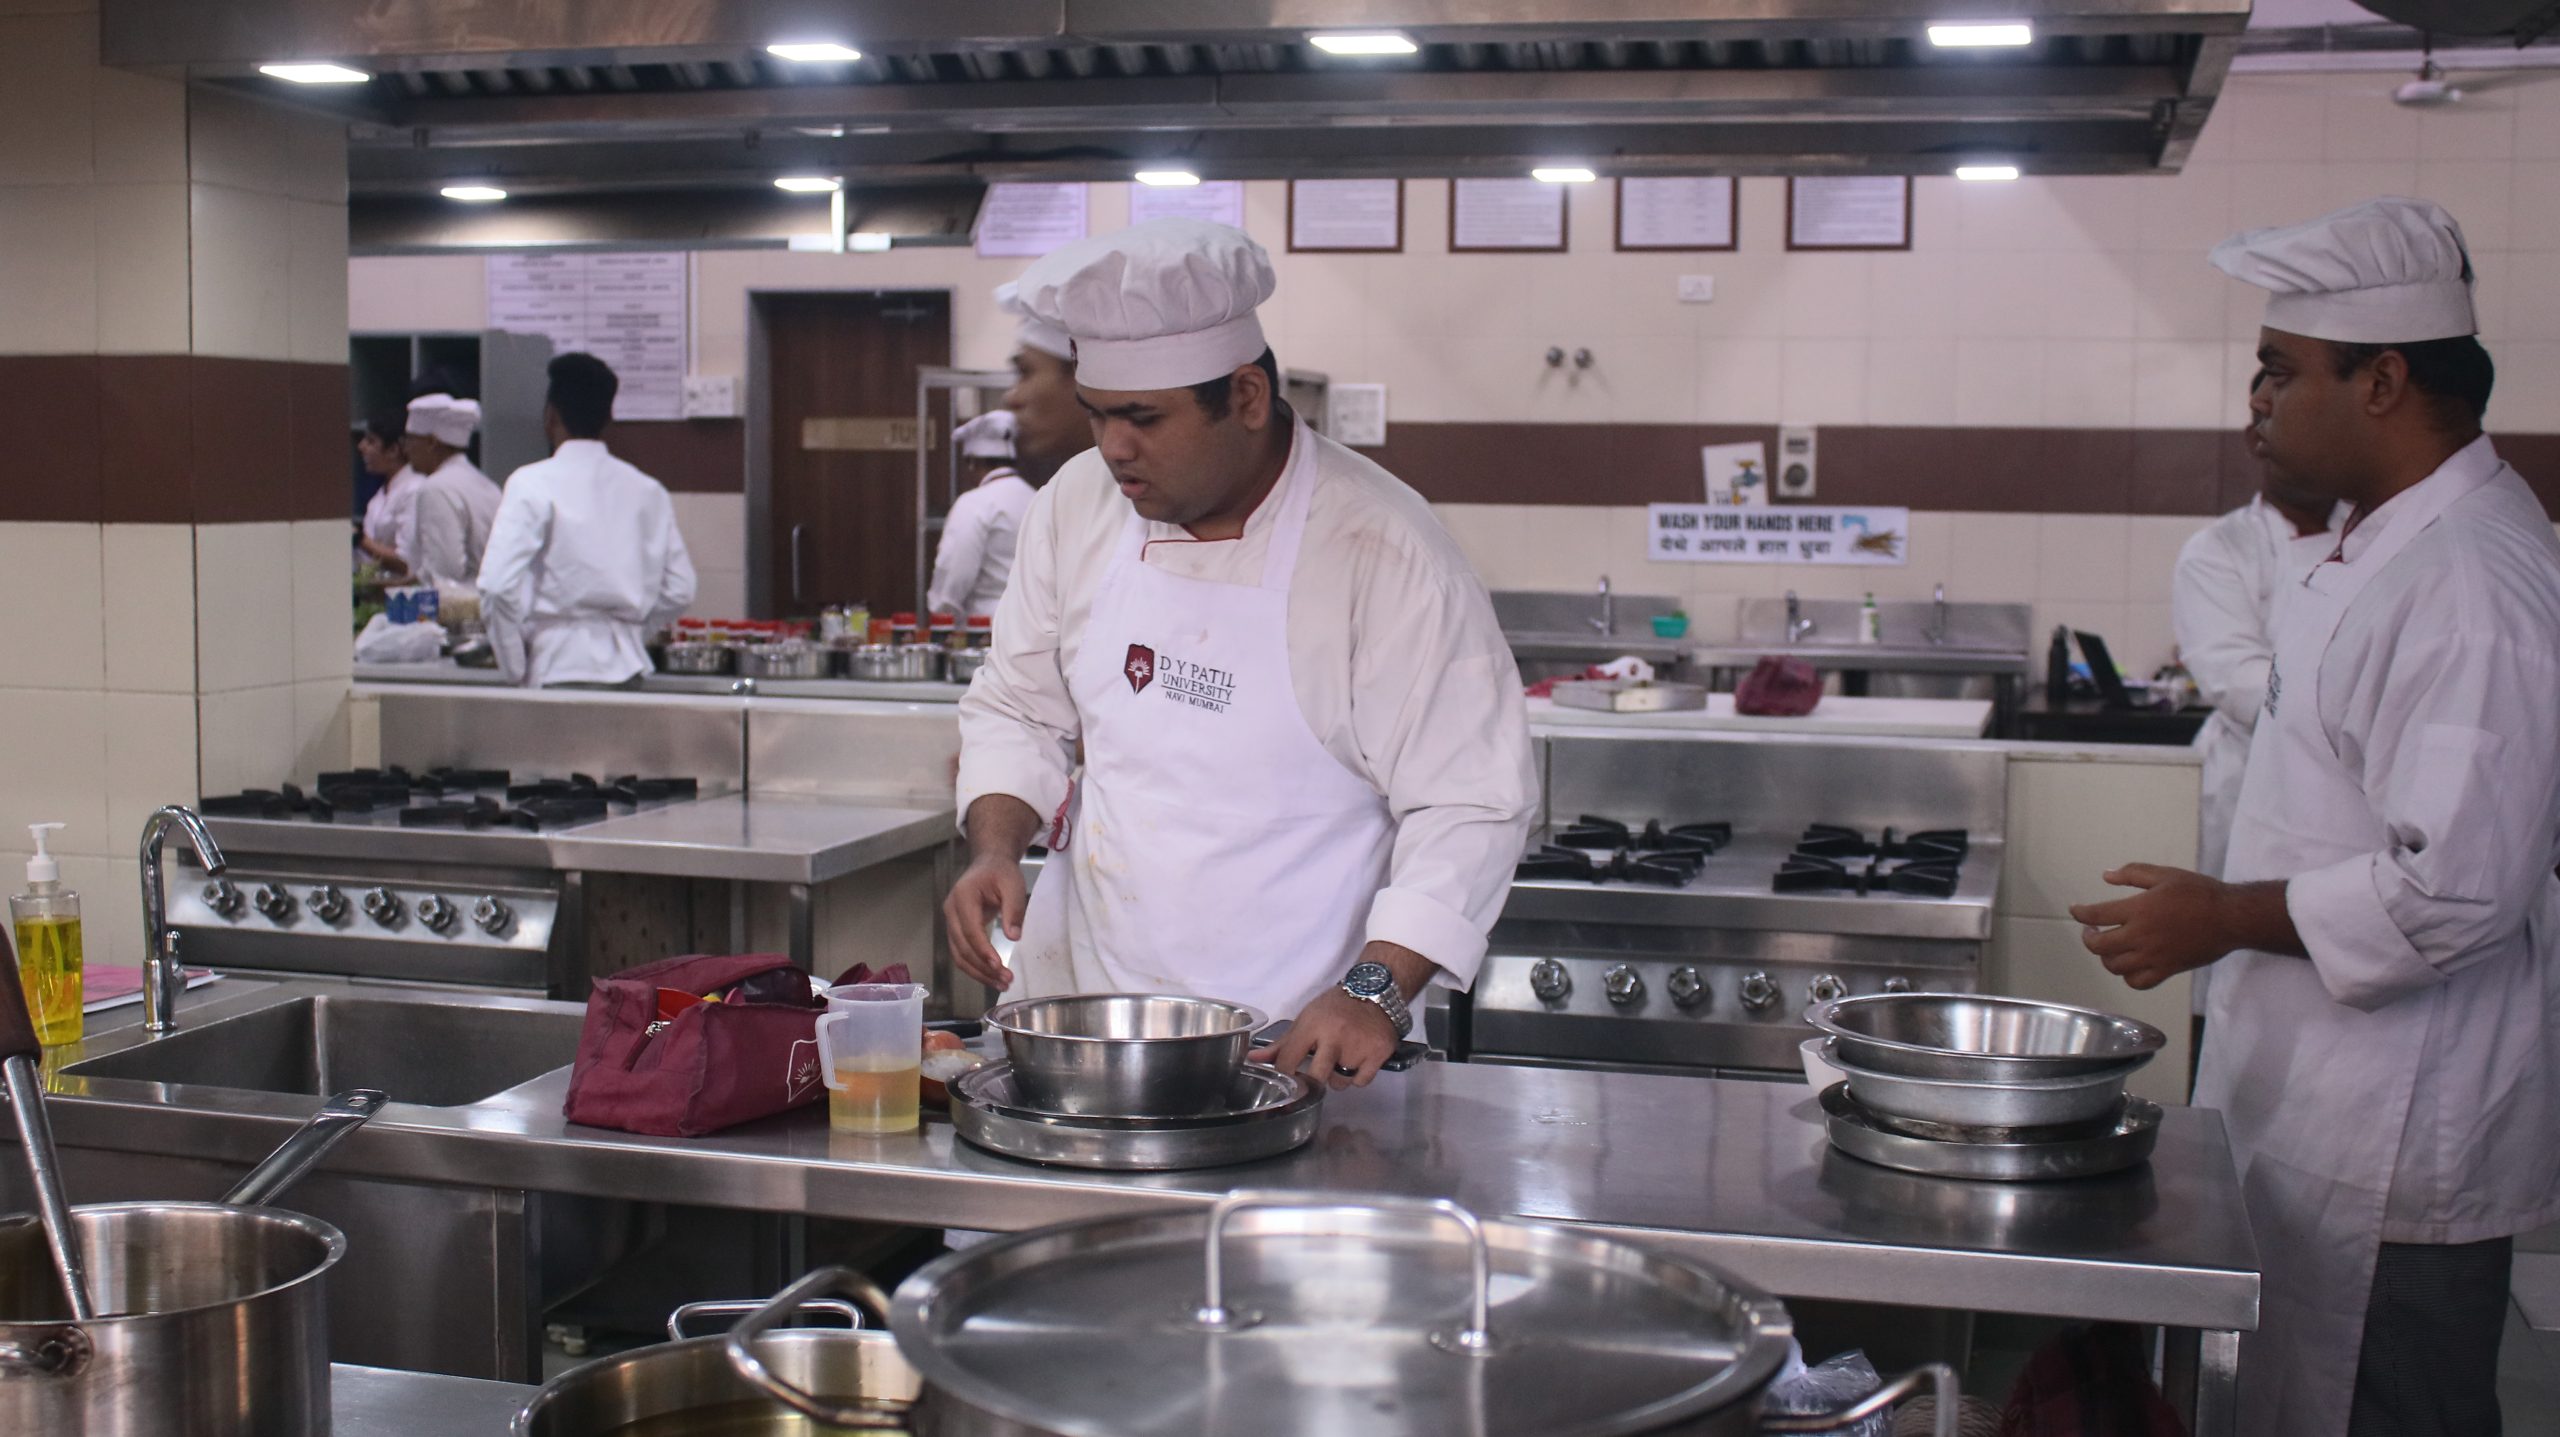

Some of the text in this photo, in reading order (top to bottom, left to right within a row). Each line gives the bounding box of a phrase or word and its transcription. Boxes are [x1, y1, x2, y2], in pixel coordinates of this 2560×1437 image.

[1659, 514, 1834, 532] WASH YOUR HANDS HERE
[1160, 655, 1236, 688] D Y PATIL
[1162, 672, 1232, 701] UNIVERSITY
[1165, 690, 1224, 713] NAVI MUMBAI
